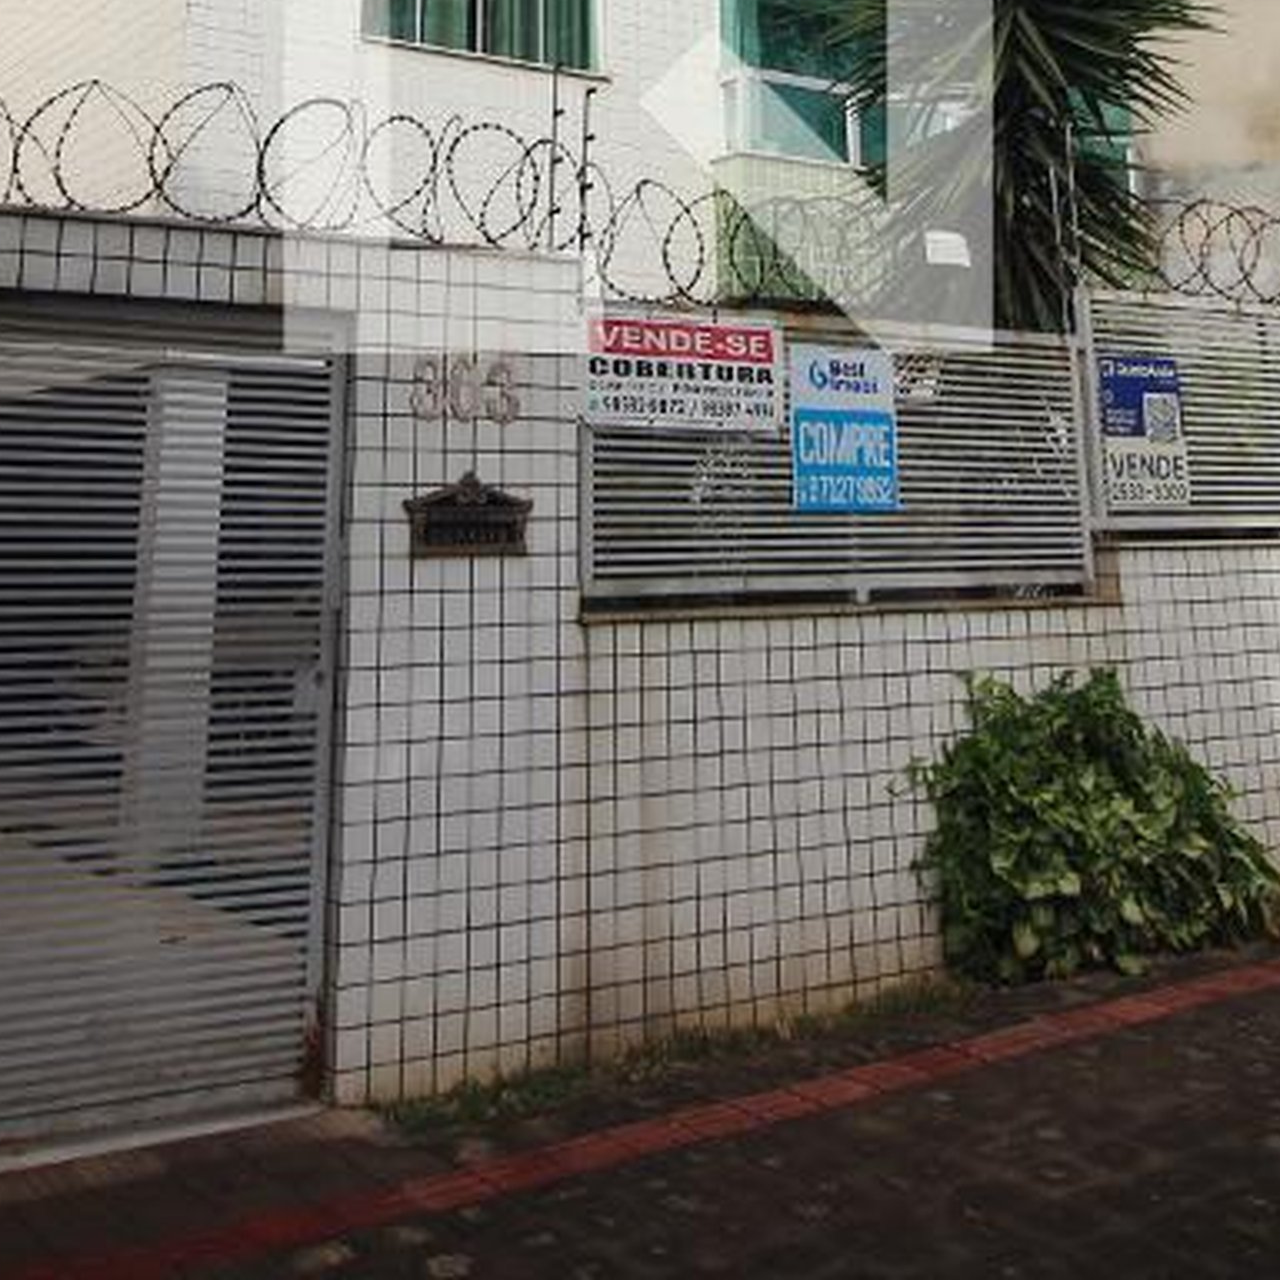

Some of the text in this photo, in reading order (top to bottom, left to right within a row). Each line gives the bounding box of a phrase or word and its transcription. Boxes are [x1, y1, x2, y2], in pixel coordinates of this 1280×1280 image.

[597, 324, 769, 358] VENDE-SE
[588, 355, 774, 385] COBERTURA
[799, 420, 891, 470] COMPRE
[1111, 453, 1185, 482] VENDE
